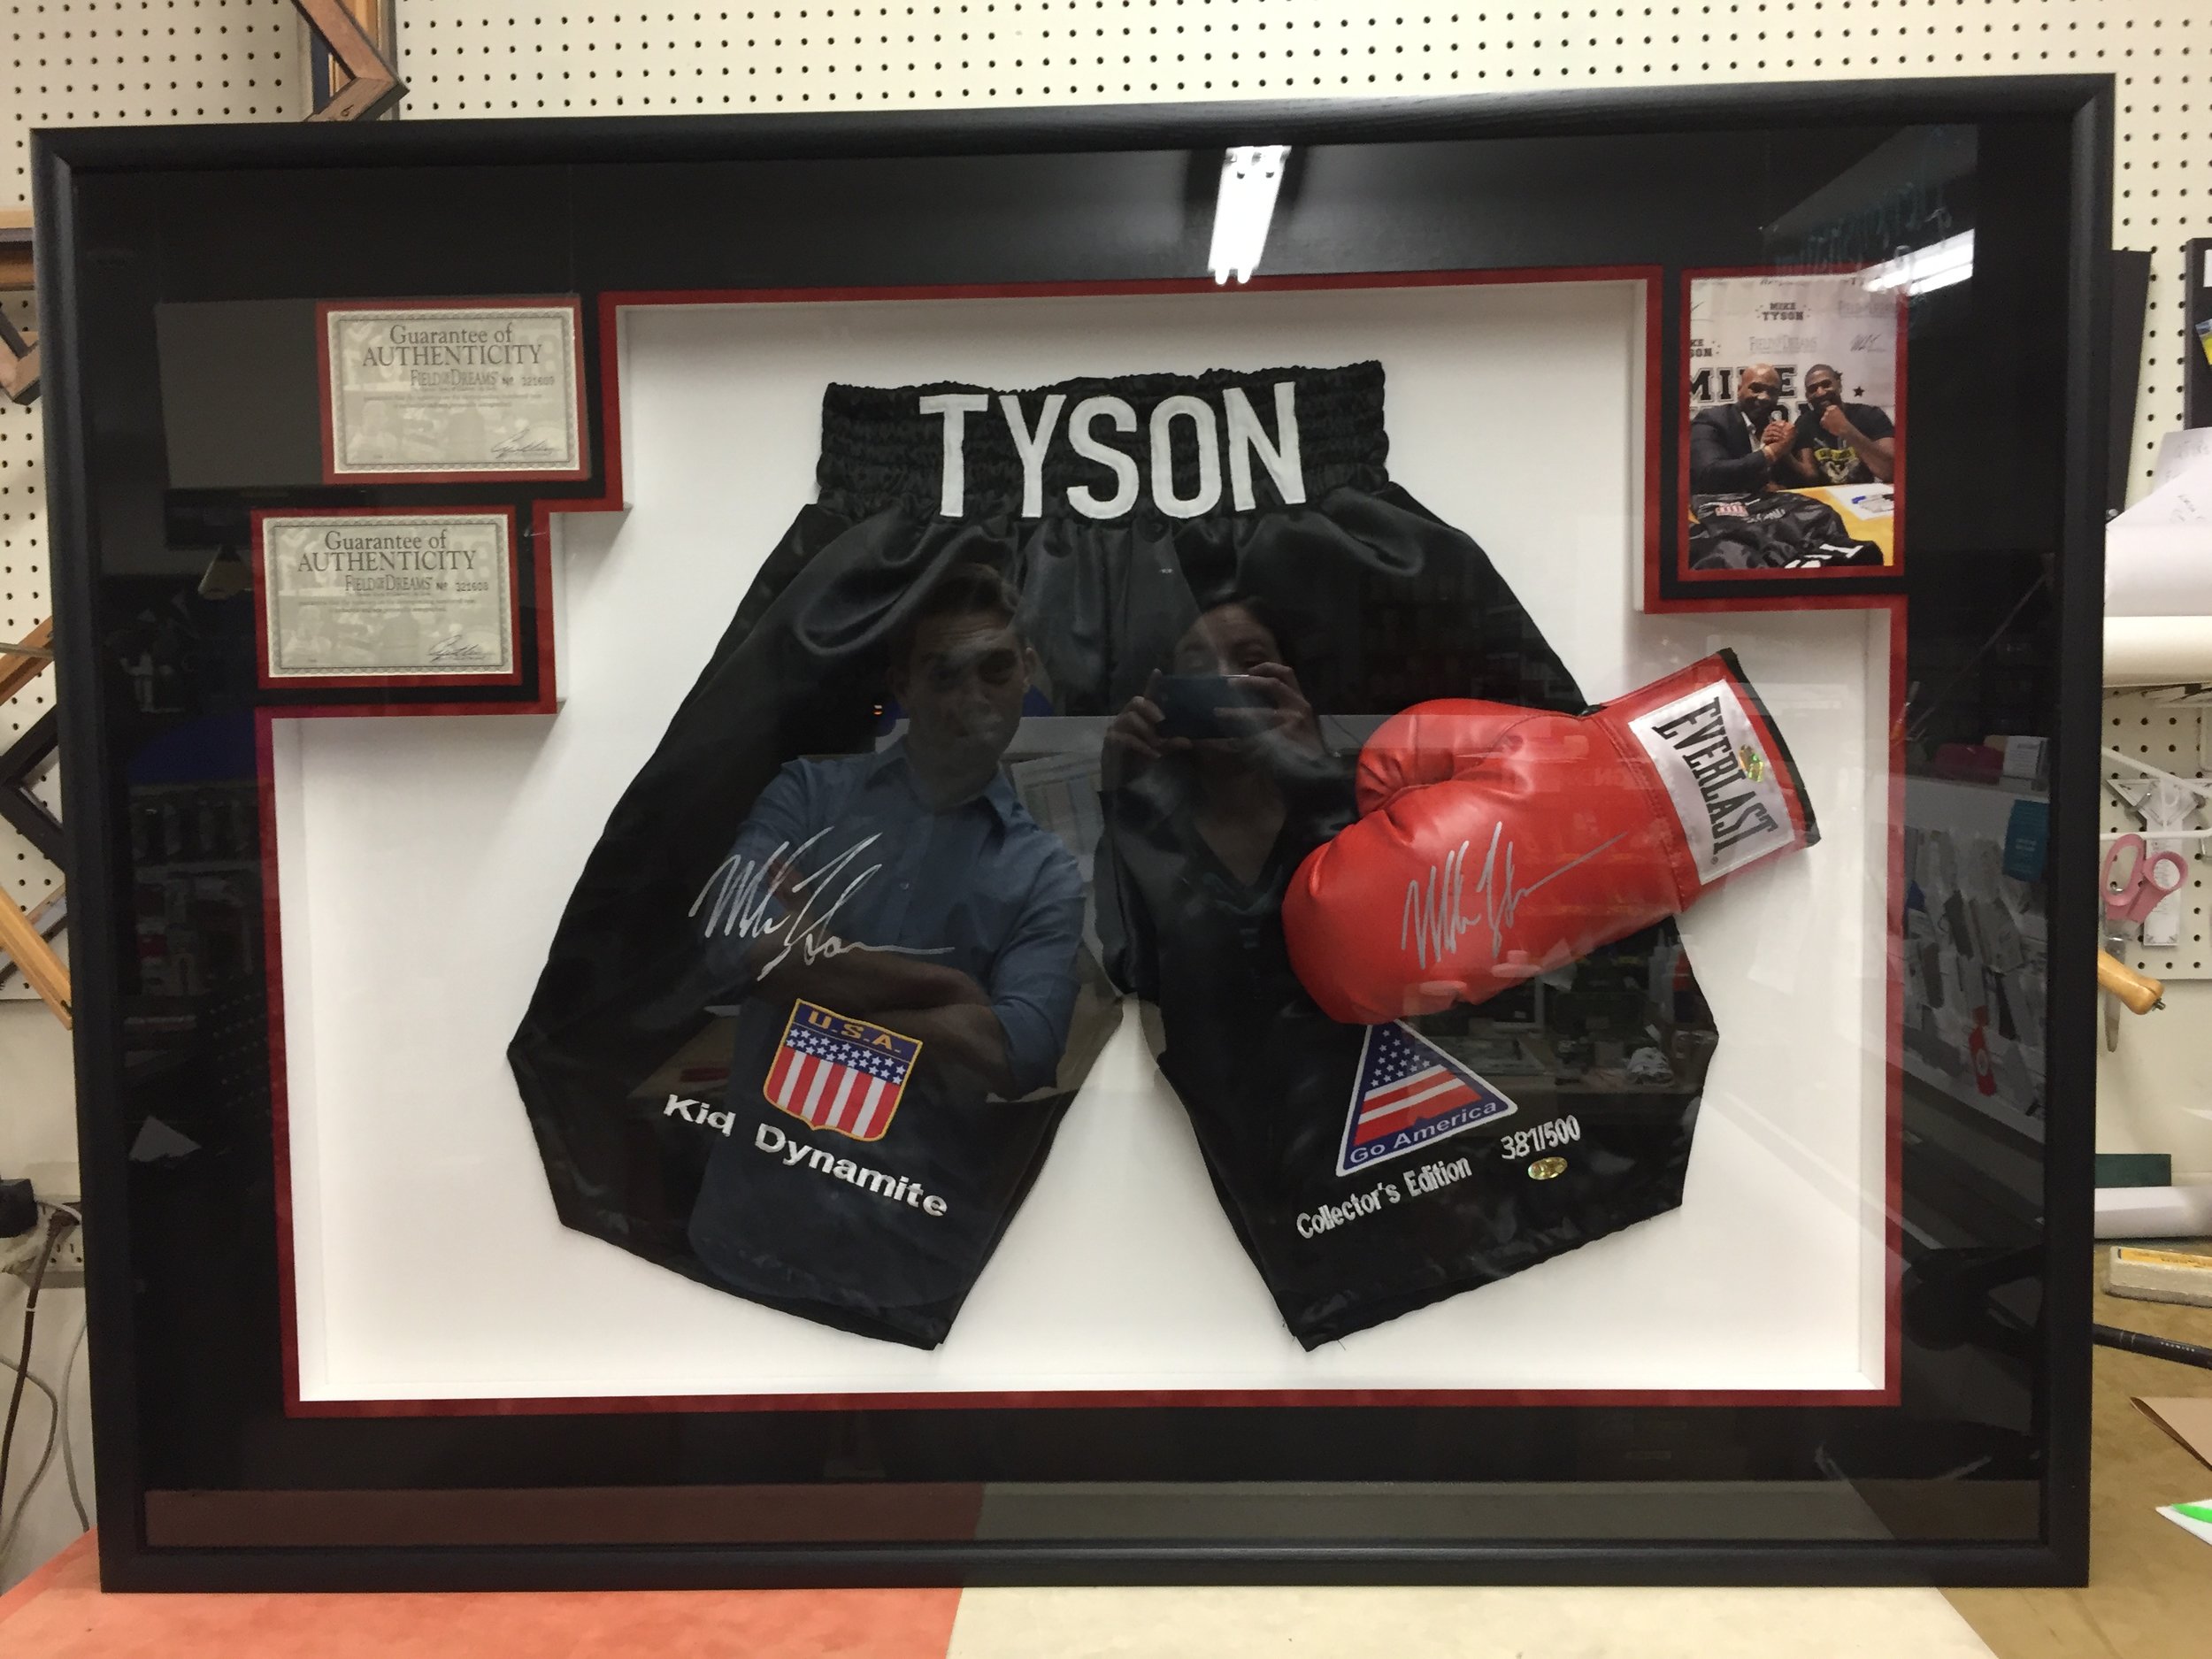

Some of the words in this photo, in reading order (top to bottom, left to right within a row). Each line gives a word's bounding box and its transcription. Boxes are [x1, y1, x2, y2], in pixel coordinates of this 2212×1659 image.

[1762, 311, 1804, 321] TYSON
[1770, 302, 1796, 311] MIKE
[390, 324, 488, 344] Guarantee
[494, 322, 513, 342] of
[363, 343, 542, 366] AUTHENTICITY
[1691, 365, 1798, 403] MIE
[918, 381, 1307, 520] TYSON
[325, 530, 422, 549] Guarantee
[429, 528, 448, 549] of
[297, 549, 476, 572] AUTHENTICITY
[1652, 696, 1778, 855] EVERLAST
[808, 1011, 902, 1054] U.S.A.
[1350, 1139, 1390, 1164] Go
[1394, 1099, 1498, 1149] America
[1500, 1114, 1581, 1159] 381/500
[663, 1094, 736, 1139] Kid
[754, 1122, 948, 1218] Dynamite
[1296, 1180, 1402, 1240] Collector's
[1403, 1154, 1473, 1198] Edition
